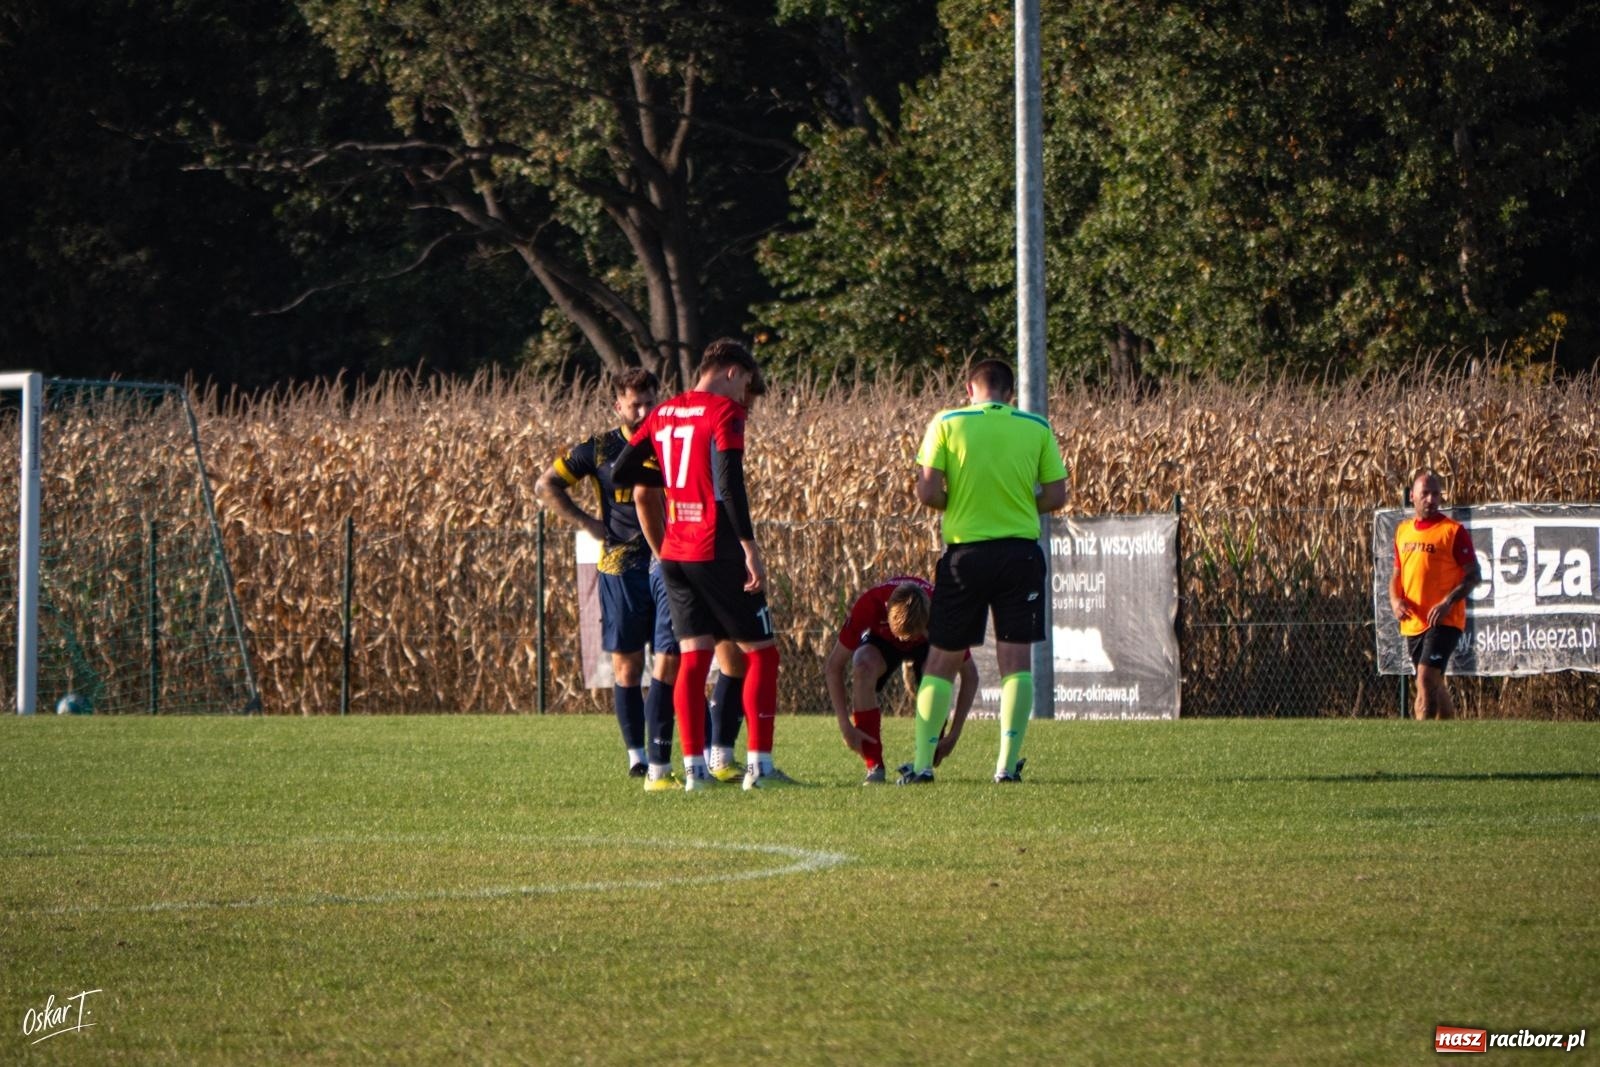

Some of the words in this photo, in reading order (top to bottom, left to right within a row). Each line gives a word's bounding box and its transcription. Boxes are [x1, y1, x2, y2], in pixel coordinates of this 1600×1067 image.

[655, 425, 695, 488] 17
[1075, 531, 1098, 556] niż
[1100, 531, 1166, 560] wszystkie
[1474, 537, 1593, 600] eeza
[1051, 572, 1106, 593] OKINAWA
